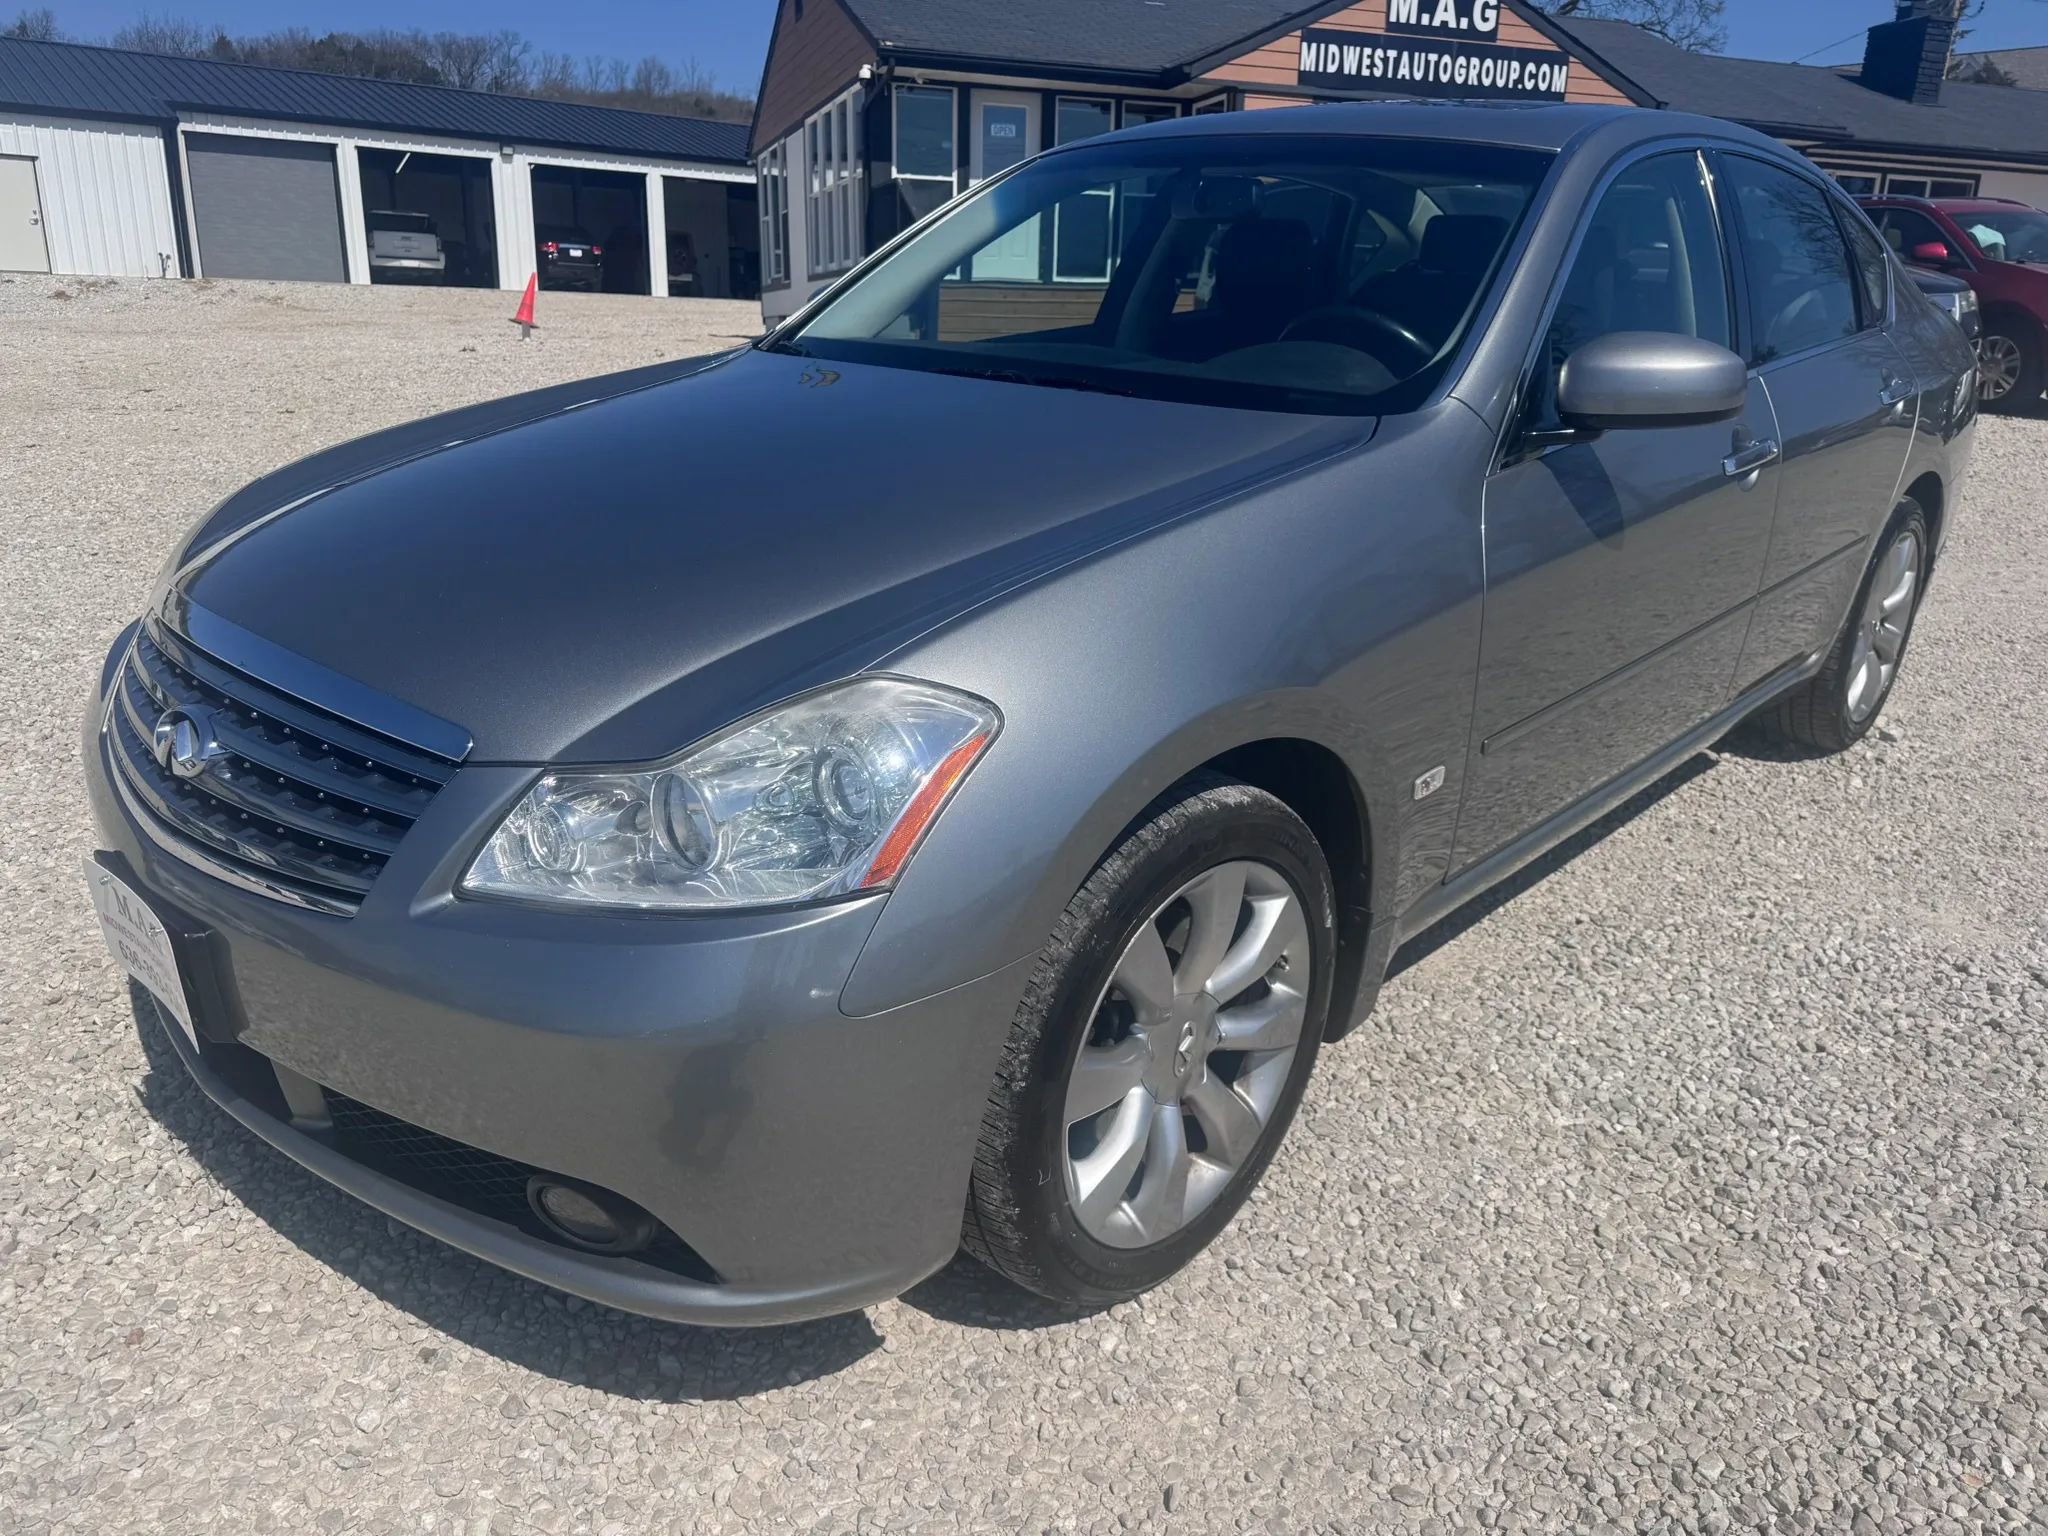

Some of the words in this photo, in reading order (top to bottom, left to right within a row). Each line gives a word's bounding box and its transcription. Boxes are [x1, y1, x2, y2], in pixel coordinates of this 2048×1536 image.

[1389, 0, 1498, 32] M.A.G
[1300, 42, 1568, 94] MIDWESTAUTOGROUP.COM
[993, 126, 1014, 136] OPEN
